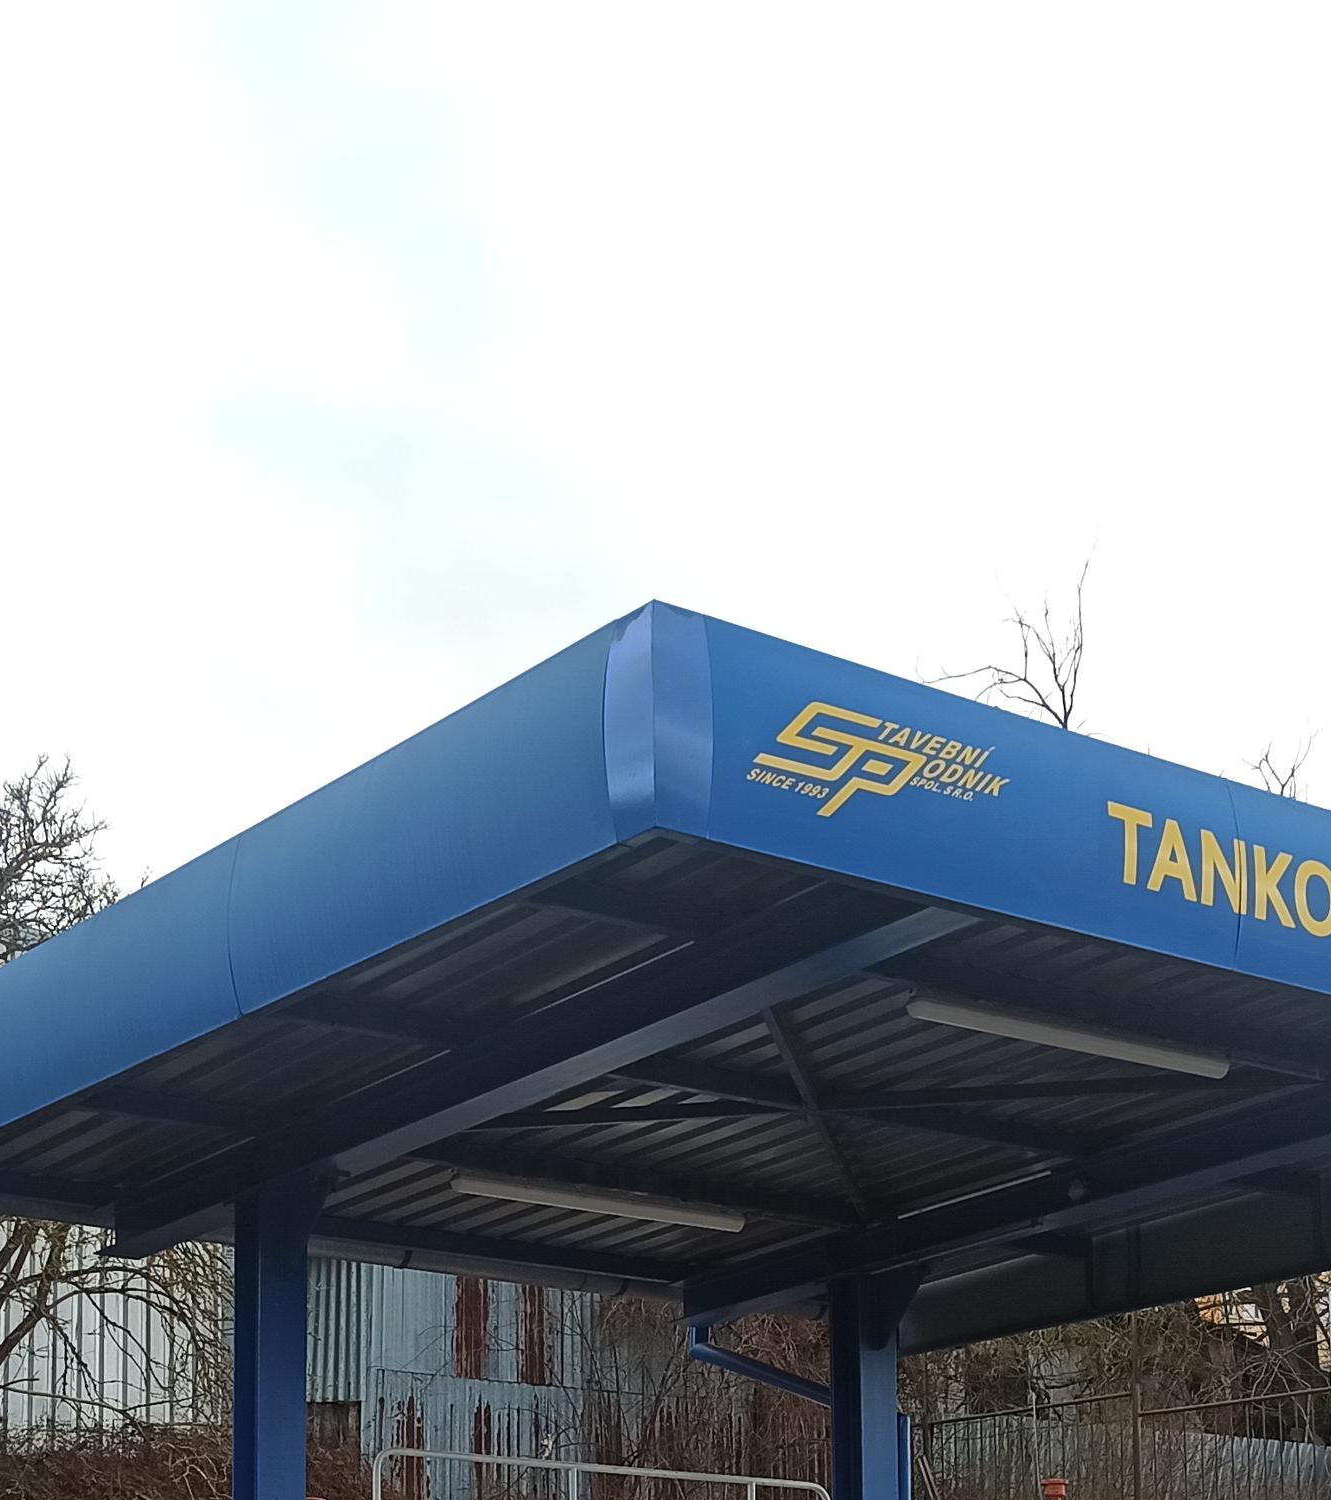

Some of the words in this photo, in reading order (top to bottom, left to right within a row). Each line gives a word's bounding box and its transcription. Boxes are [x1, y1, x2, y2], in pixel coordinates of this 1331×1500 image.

[877, 722, 996, 768] TAVEBNÍ
[746, 768, 796, 790] SINCE
[796, 780, 830, 799] 1993
[922, 760, 1010, 797] ODNIK
